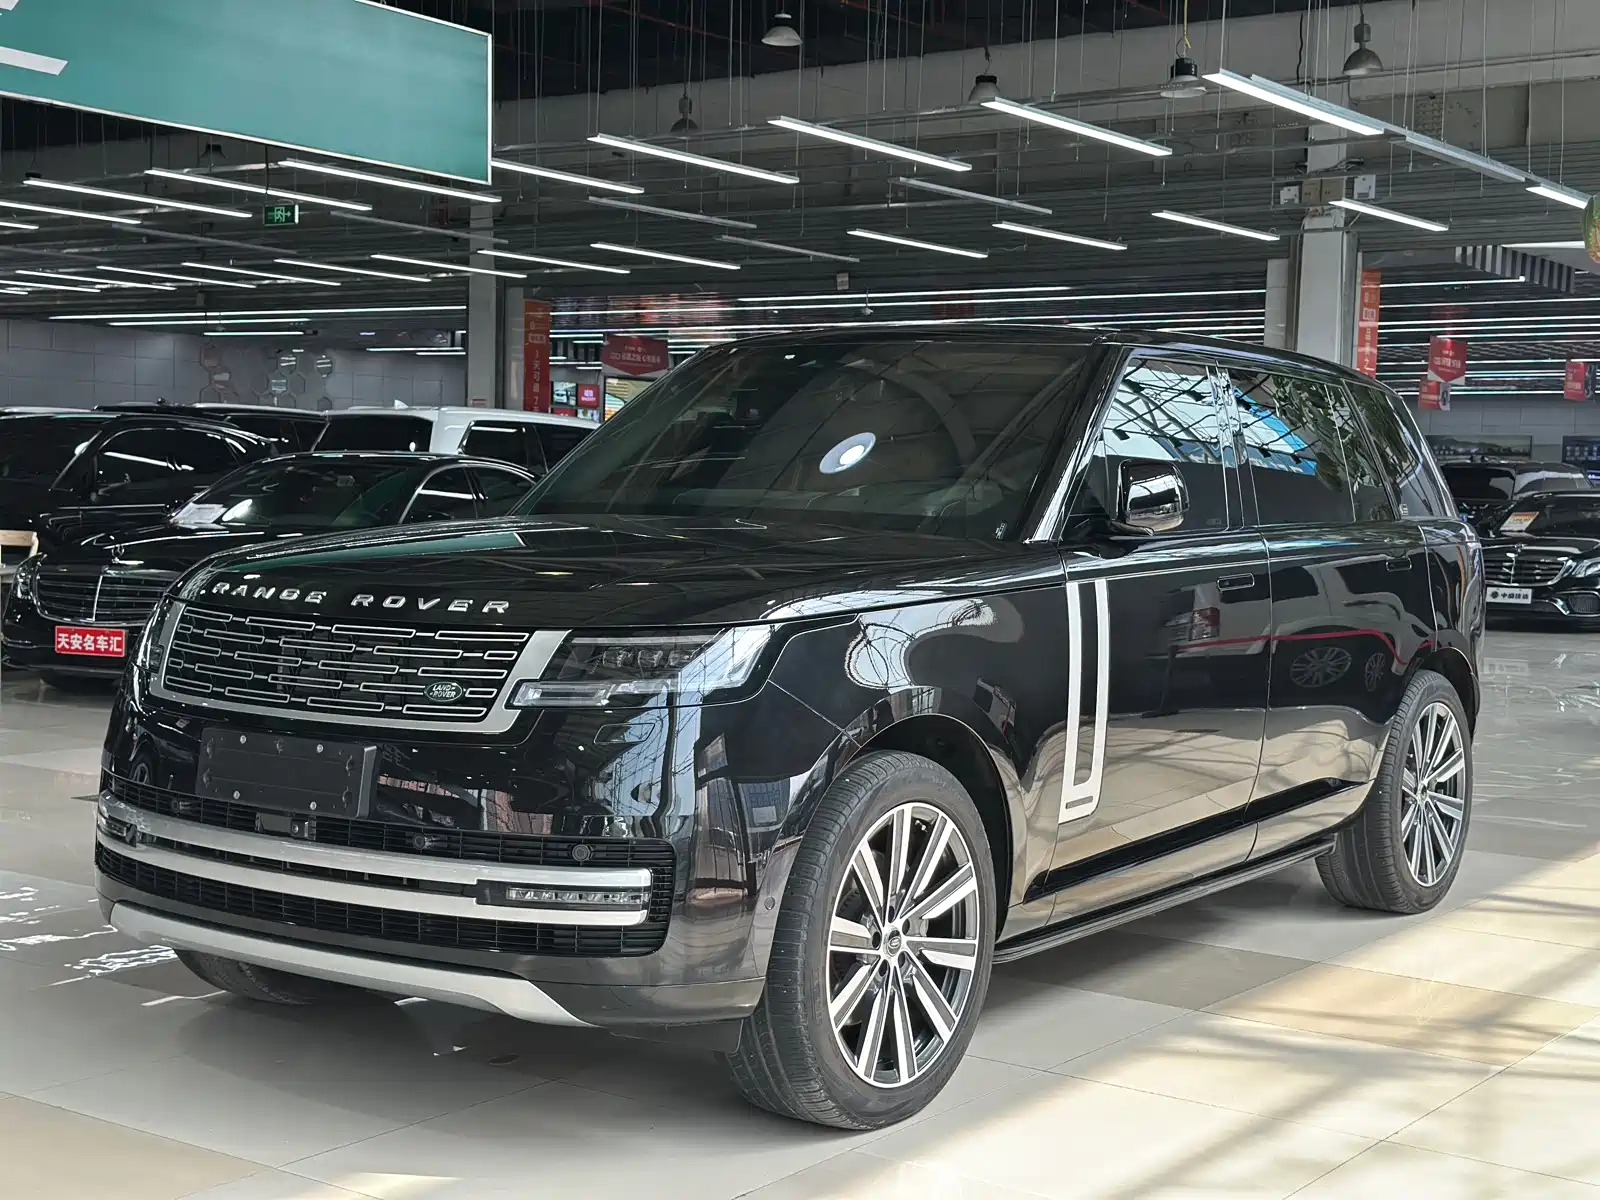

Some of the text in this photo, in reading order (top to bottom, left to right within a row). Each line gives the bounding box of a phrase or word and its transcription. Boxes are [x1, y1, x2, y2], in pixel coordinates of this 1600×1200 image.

[211, 580, 510, 614] RANGE ROVER
[57, 632, 122, 652] 天安名车汇
